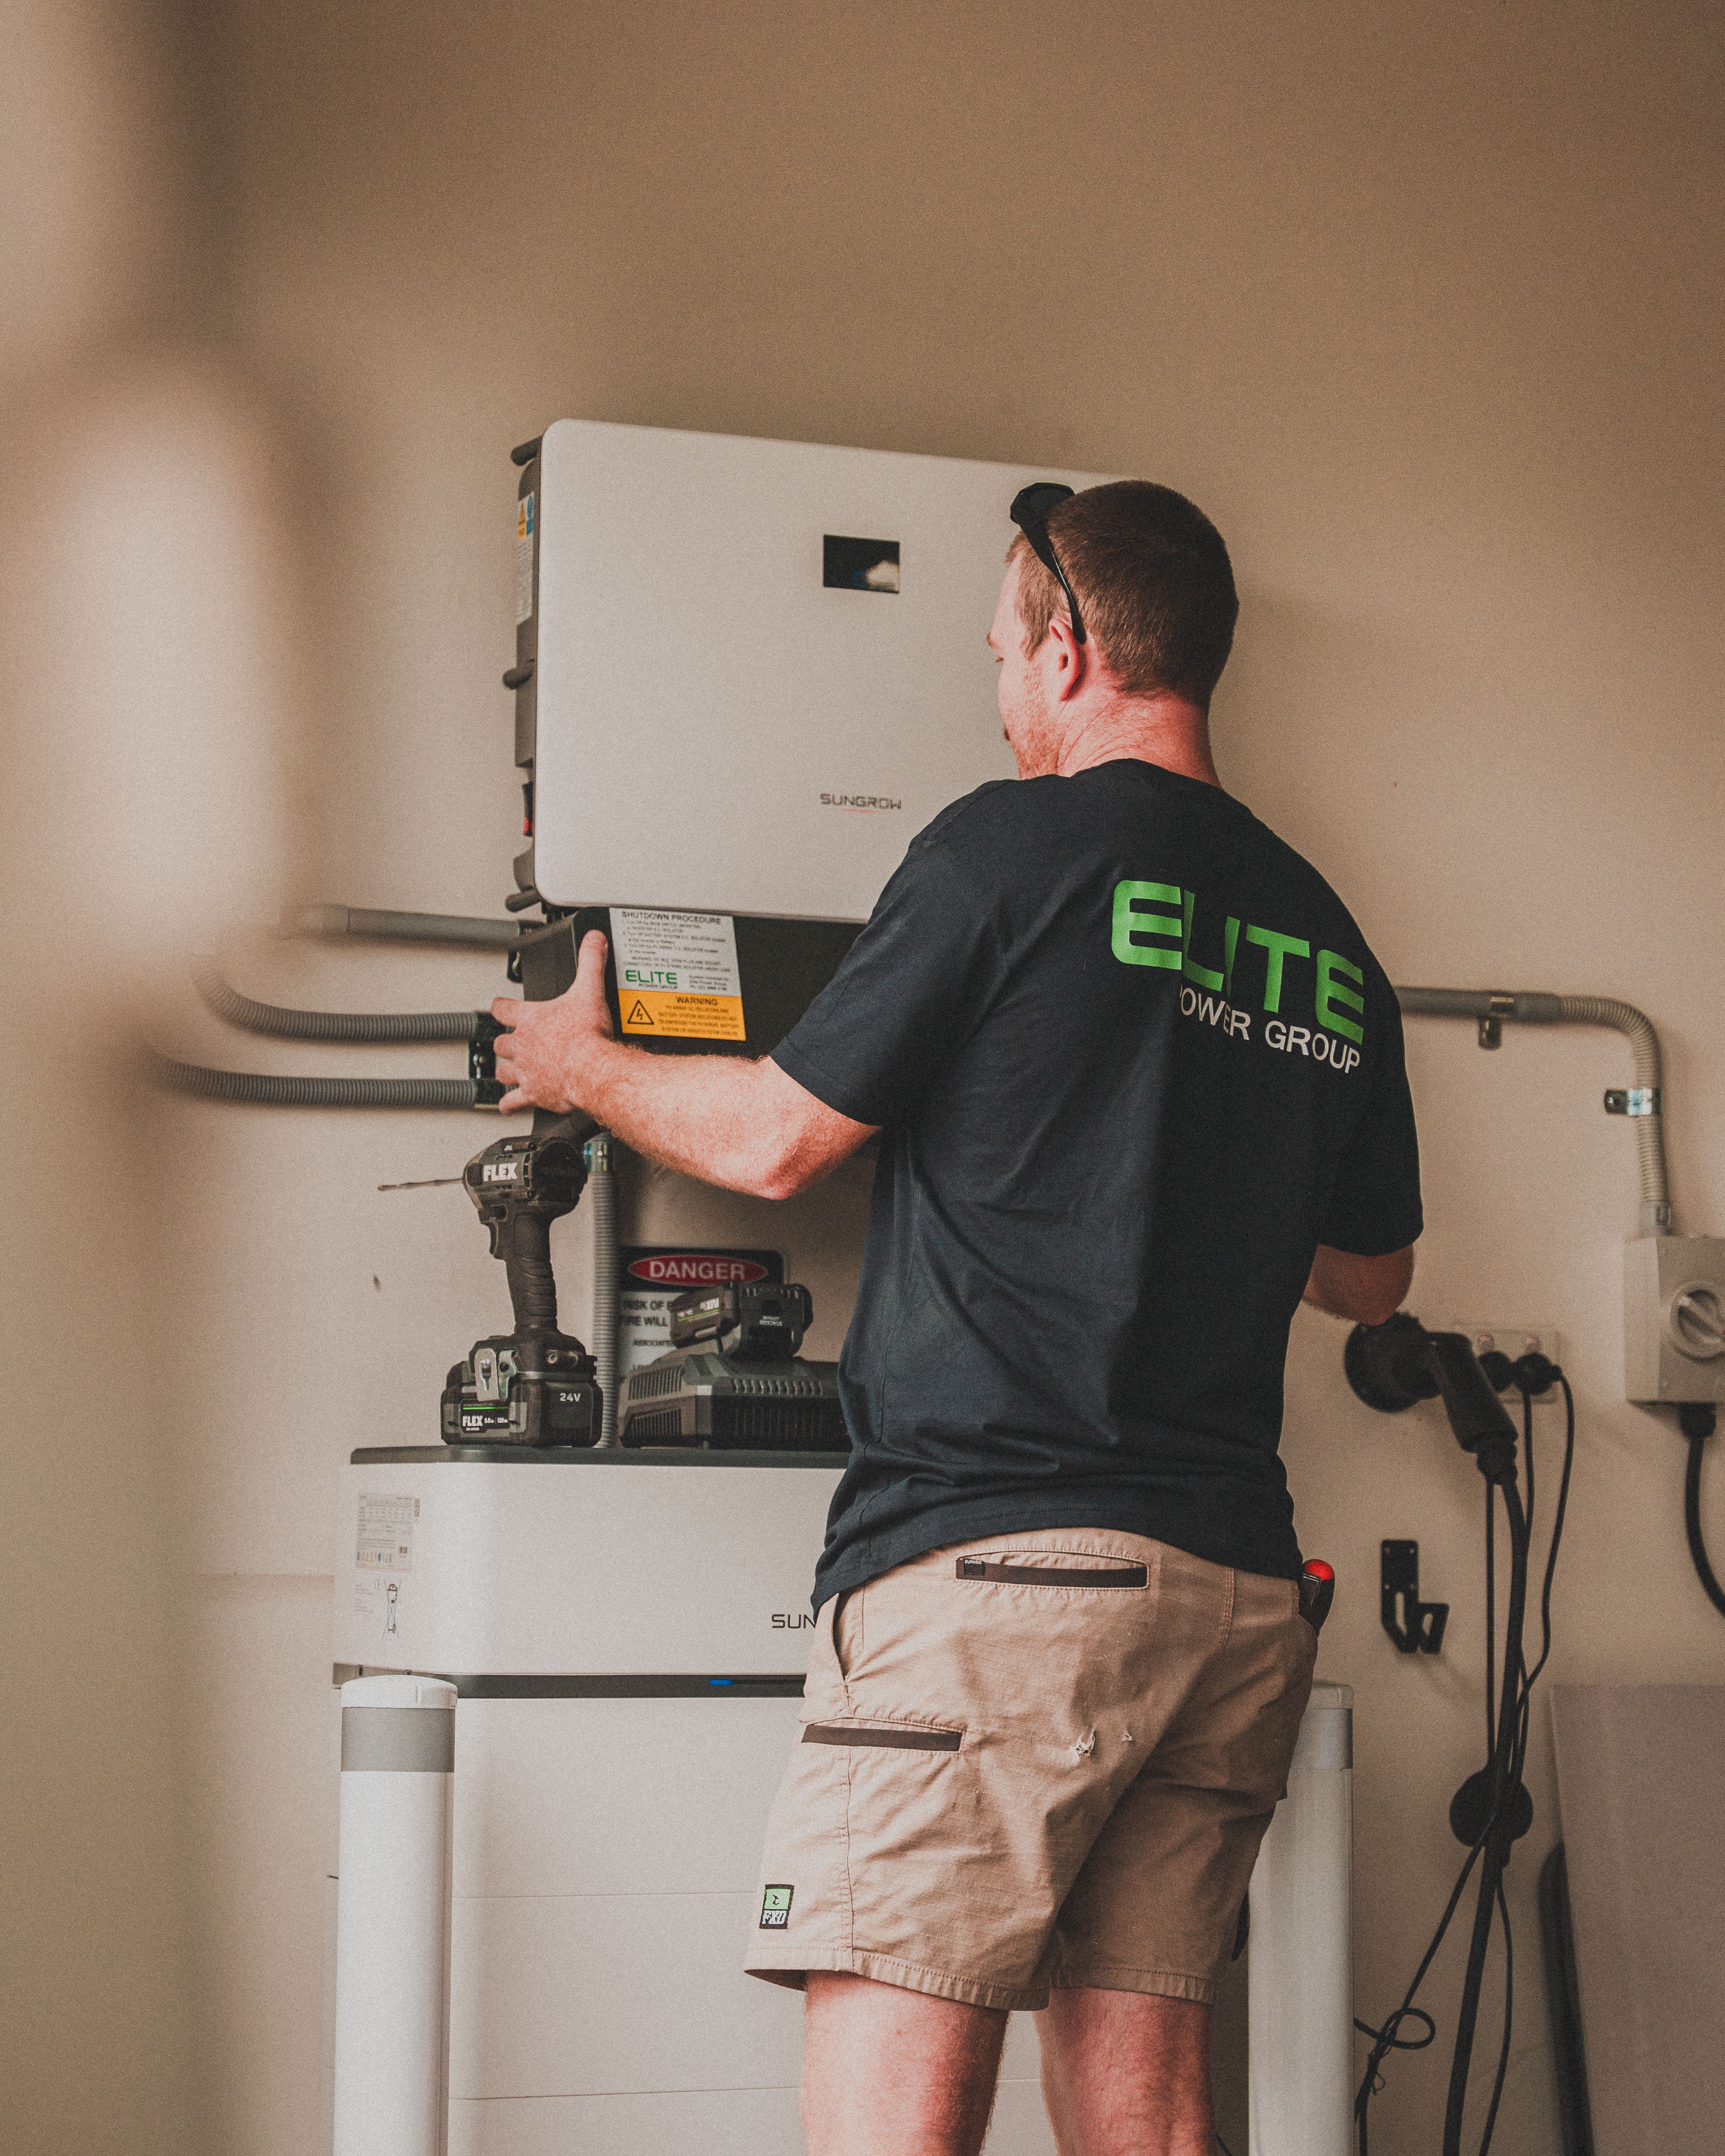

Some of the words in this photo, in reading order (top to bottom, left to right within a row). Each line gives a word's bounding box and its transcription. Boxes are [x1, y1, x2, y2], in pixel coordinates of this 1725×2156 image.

[820, 793, 902, 810] SUNGROW
[622, 911, 669, 920] SHUTDOWN
[671, 915, 722, 925] PROCEDURE
[1112, 879, 1364, 1045] ELITE
[625, 970, 677, 985] ELITE
[676, 996, 717, 1006] WARNING
[1180, 984, 1251, 1040] OWER
[1265, 1020, 1360, 1074] GROUP
[483, 1162, 518, 1182] FLEX
[650, 1261, 745, 1280] DANGER
[644, 1316, 668, 1326] WILL
[560, 1393, 581, 1402] 24V
[462, 1415, 483, 1426] FLEX
